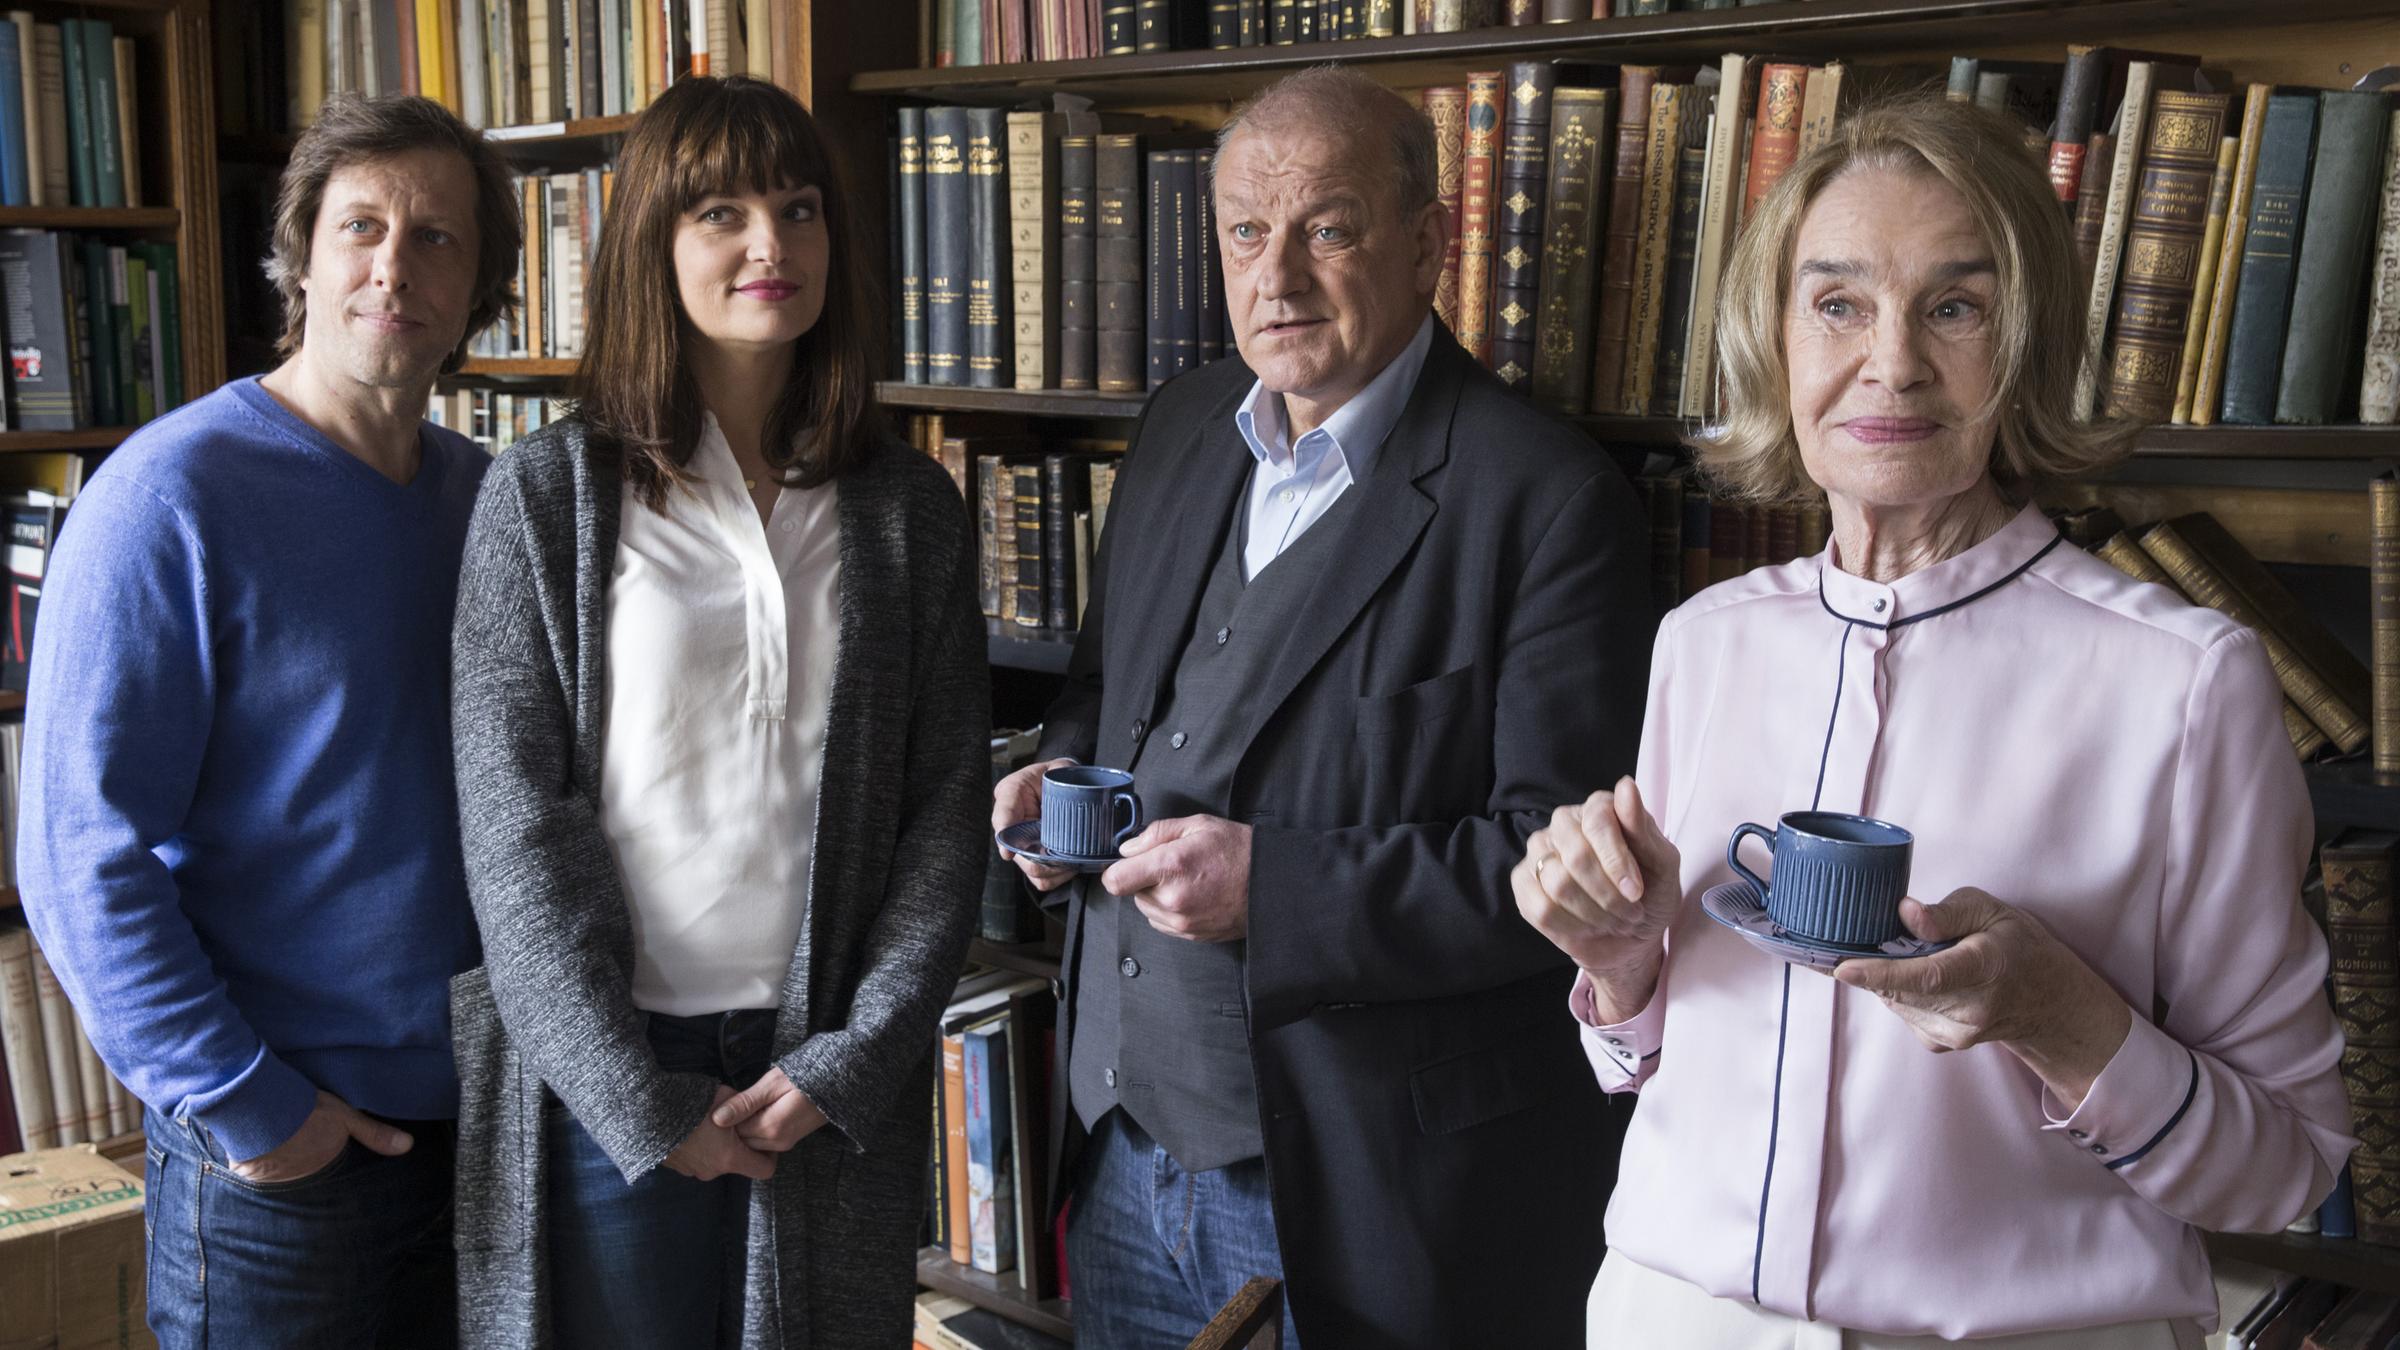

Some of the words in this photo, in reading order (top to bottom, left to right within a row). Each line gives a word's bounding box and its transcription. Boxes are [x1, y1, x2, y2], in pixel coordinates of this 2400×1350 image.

[1656, 106, 1670, 125] The
[2122, 102, 2138, 155] EINMAL
[1652, 129, 1666, 186] RUSSIAN
[1715, 163, 1724, 181] DER
[2116, 163, 2130, 193] WAR
[1647, 189, 1660, 245] SCHOOL
[2112, 200, 2123, 216] ES
[1639, 262, 1652, 321] PAINTING
[2336, 959, 2391, 970] HONGRIE
